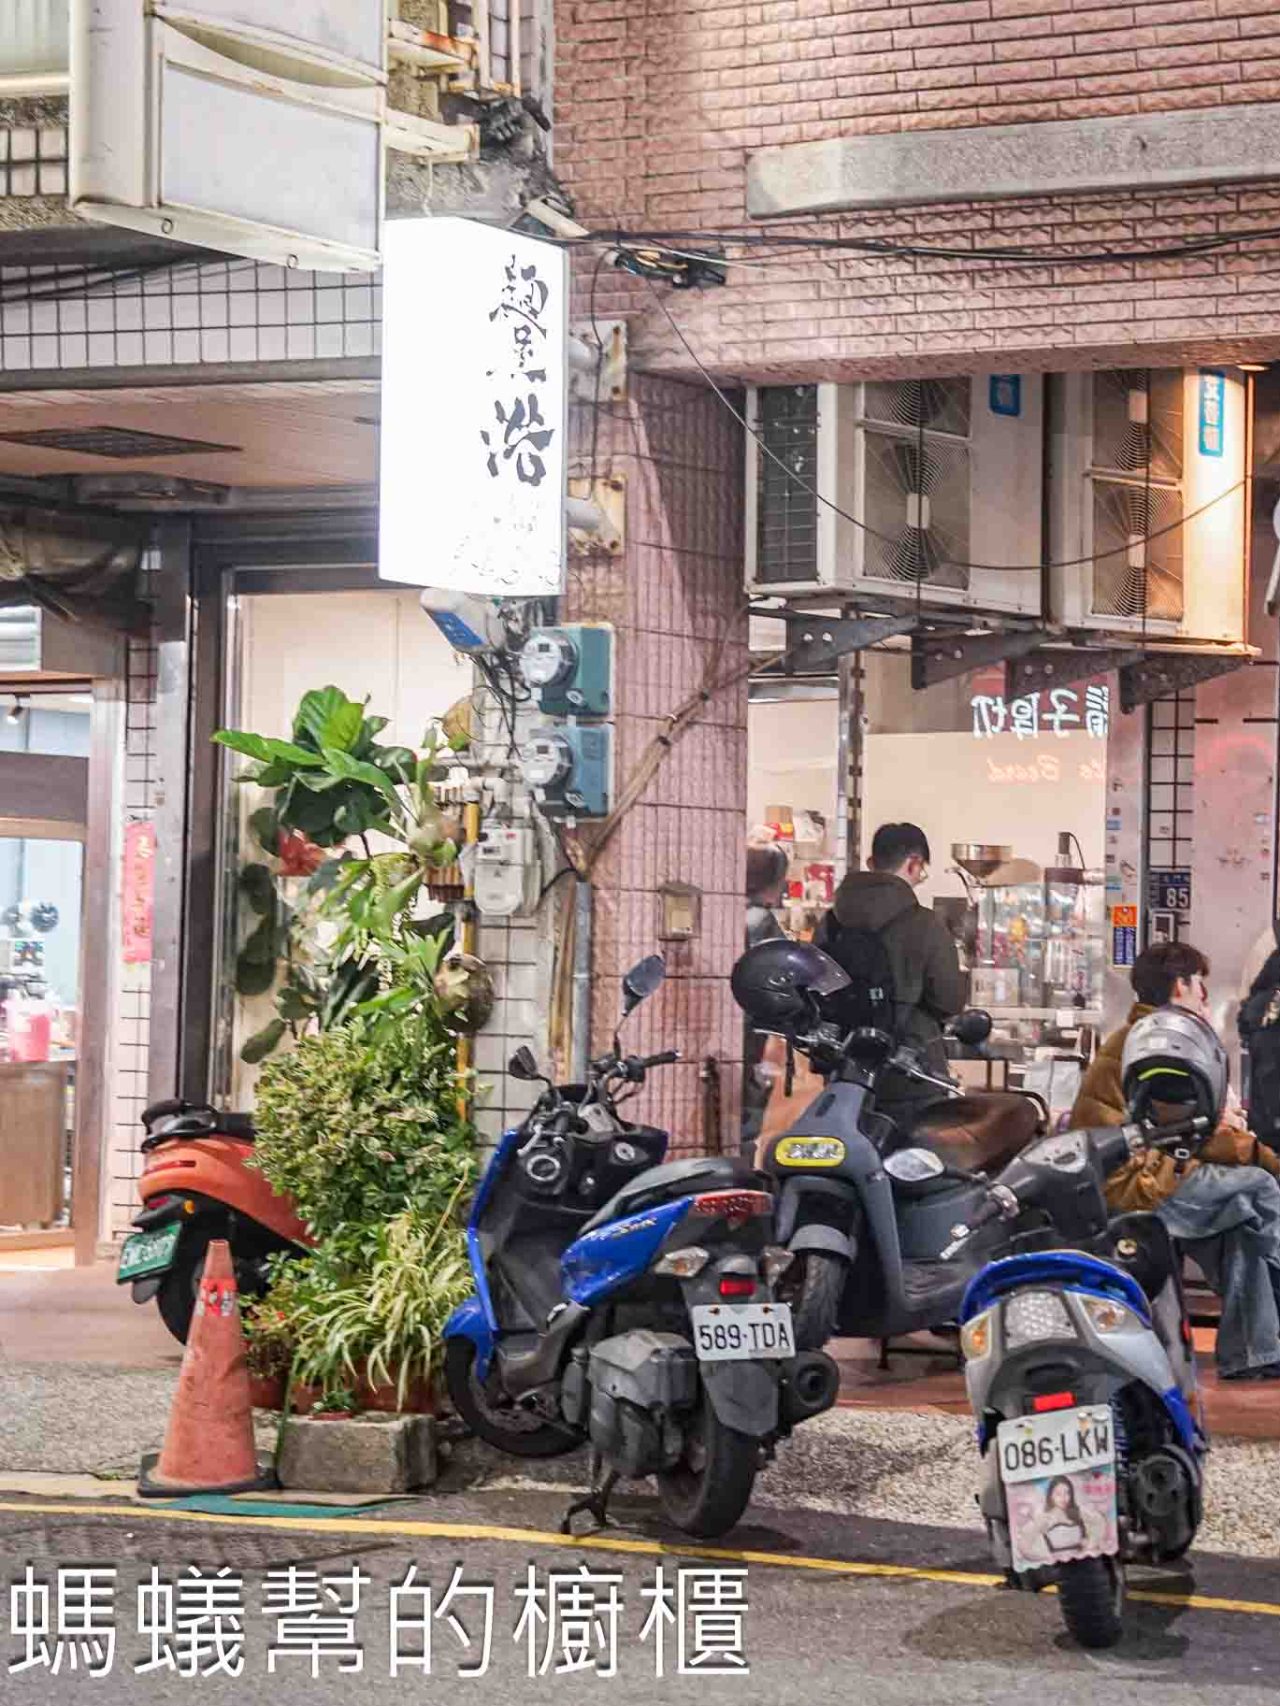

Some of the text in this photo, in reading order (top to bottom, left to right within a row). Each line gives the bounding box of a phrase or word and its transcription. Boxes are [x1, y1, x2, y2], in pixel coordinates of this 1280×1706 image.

[1166, 887, 1190, 908] 85
[697, 1321, 791, 1351] 589-TDA
[1004, 1424, 1110, 1471] 086-LKW
